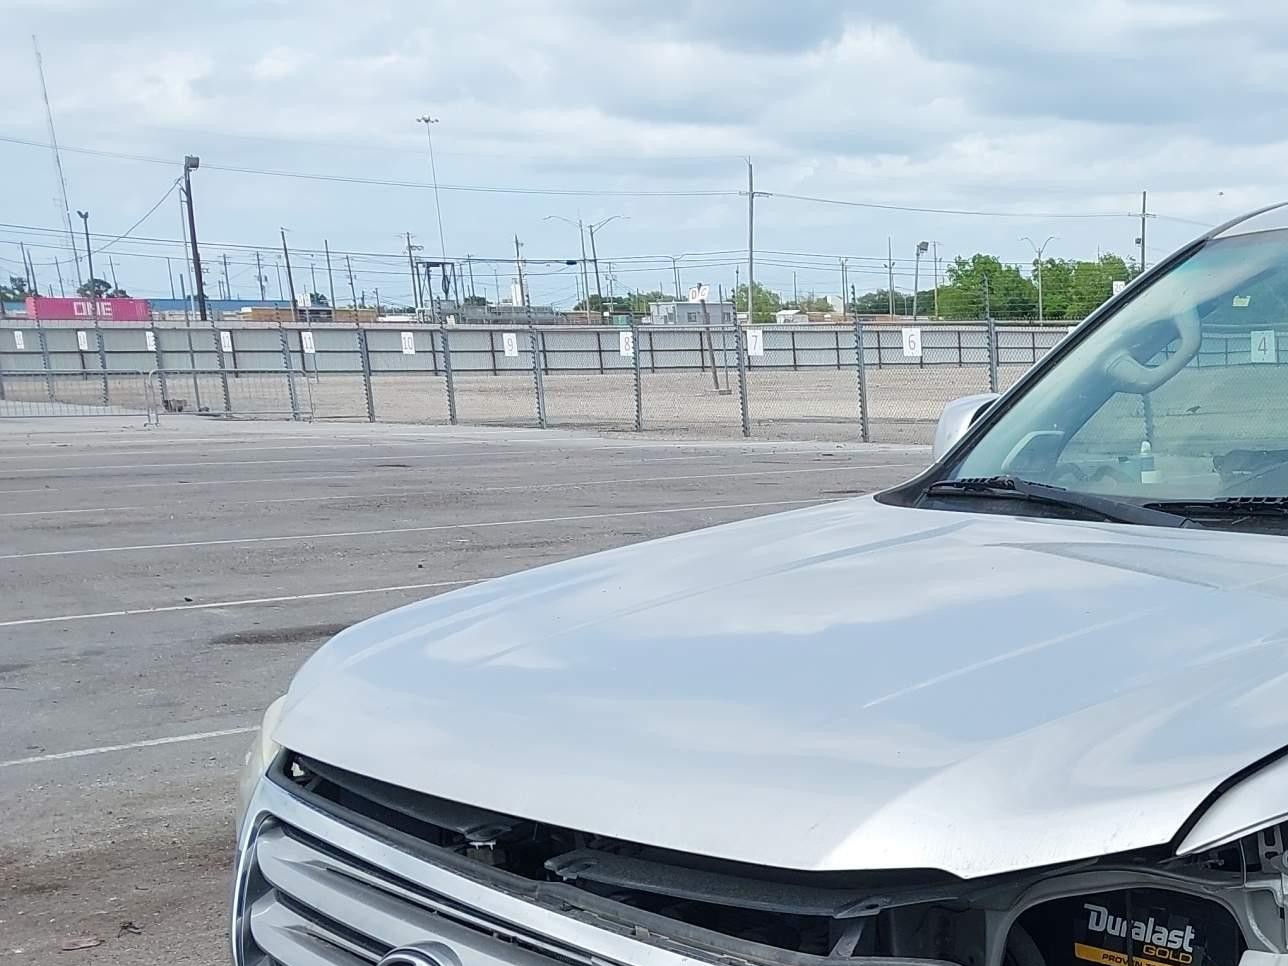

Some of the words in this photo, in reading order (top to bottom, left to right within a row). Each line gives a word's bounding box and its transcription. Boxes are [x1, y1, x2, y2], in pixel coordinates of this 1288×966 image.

[403, 336, 414, 351] 10
[507, 337, 514, 352] 9
[623, 336, 631, 352] 8
[751, 334, 759, 351] 7
[908, 333, 916, 351] 6
[1257, 336, 1267, 355] 4
[1142, 944, 1193, 964] GOLD
